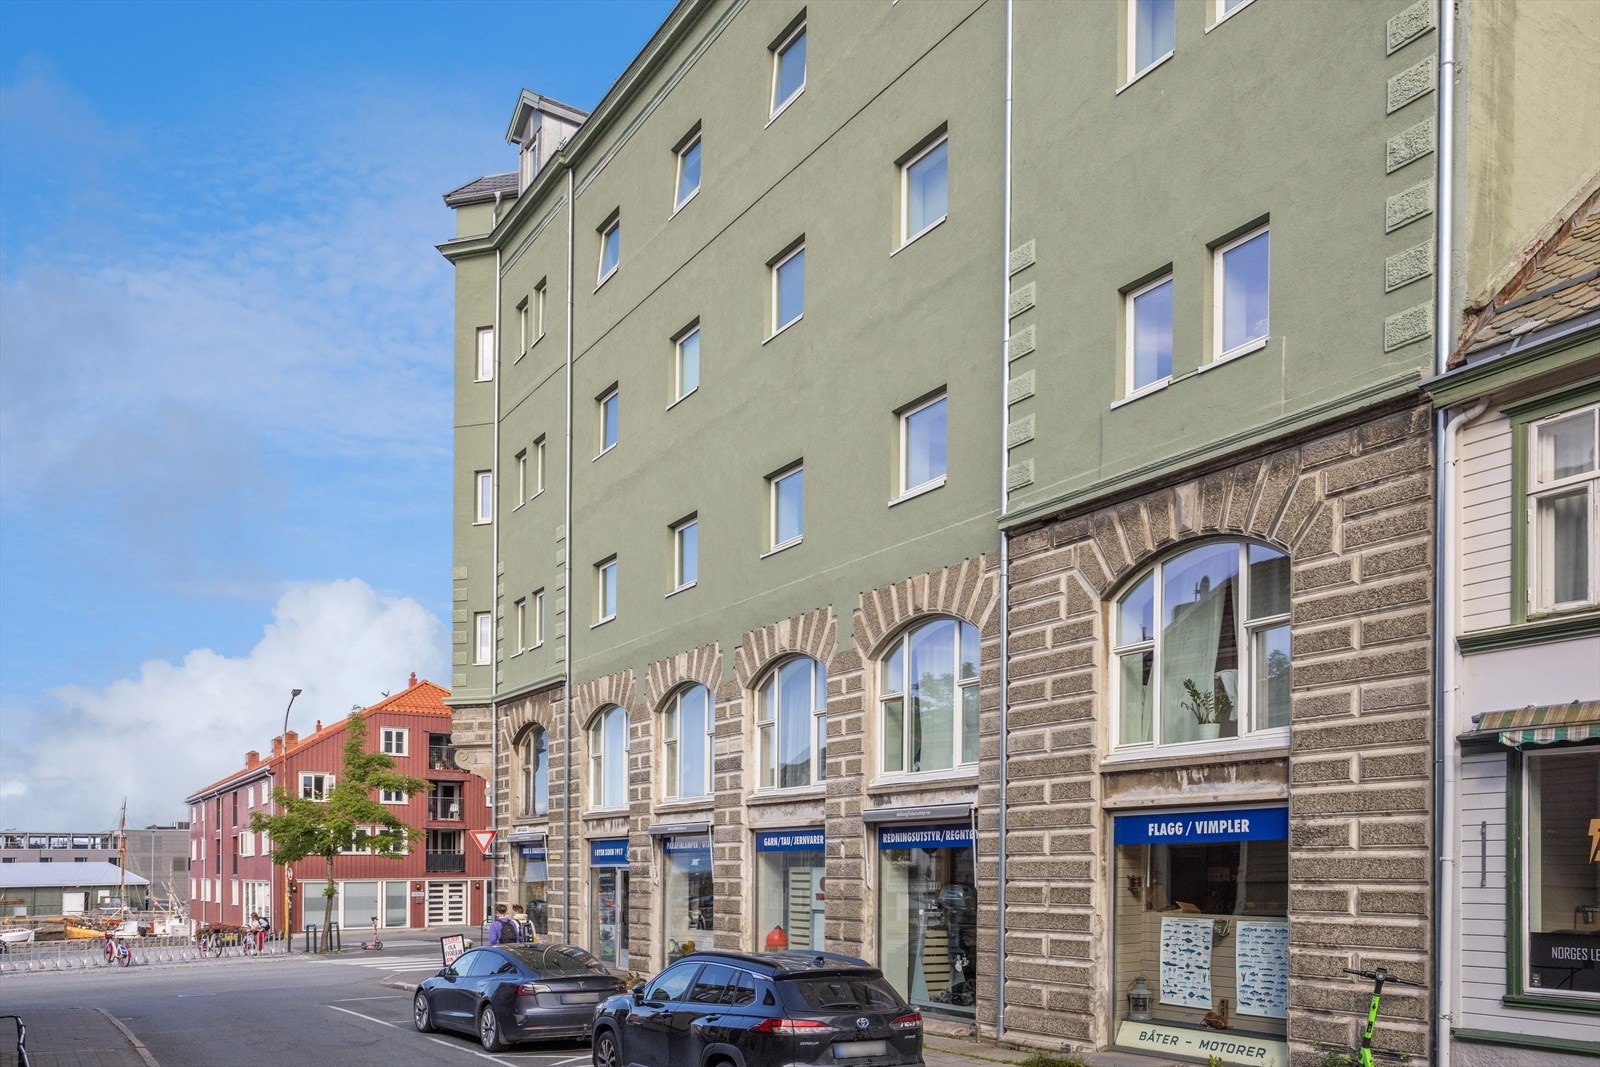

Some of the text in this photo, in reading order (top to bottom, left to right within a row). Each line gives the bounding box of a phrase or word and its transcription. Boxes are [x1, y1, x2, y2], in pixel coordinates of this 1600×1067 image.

[1148, 818, 1250, 836] FLAGG / VIMPLER
[1551, 946, 1588, 961] NORGES
[1138, 1029, 1179, 1046] BÅTER
[1198, 1039, 1267, 1058] MOTORER
